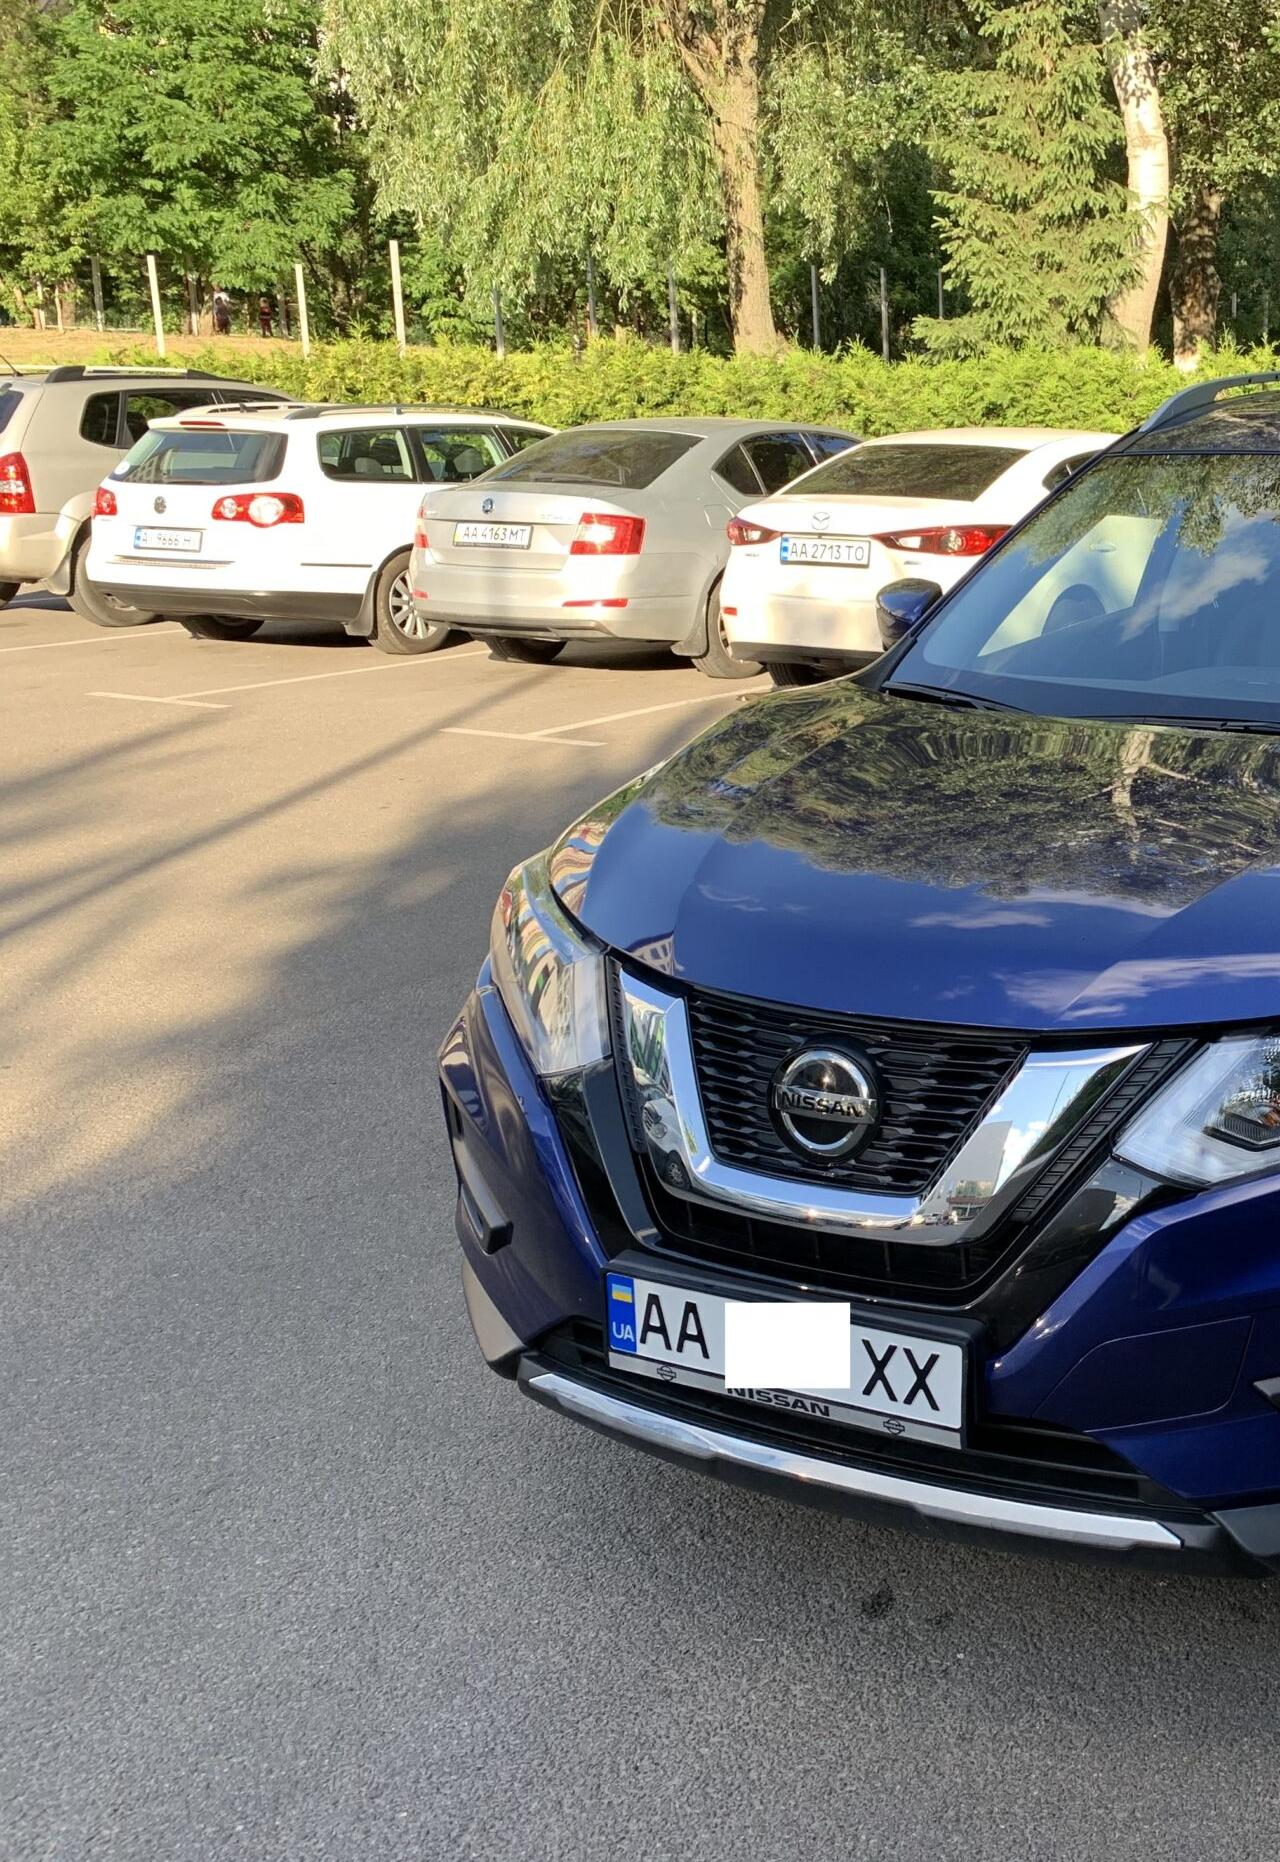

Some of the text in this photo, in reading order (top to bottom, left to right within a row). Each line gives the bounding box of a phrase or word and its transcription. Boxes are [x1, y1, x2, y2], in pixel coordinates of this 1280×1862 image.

[463, 526, 527, 541] AA 4163 MT
[789, 543, 865, 562] AA 2713 TO
[781, 1091, 864, 1118] NISSAN
[612, 1321, 635, 1343] UA
[639, 1293, 940, 1412] AA XX
[726, 1388, 831, 1417] NISSAN
